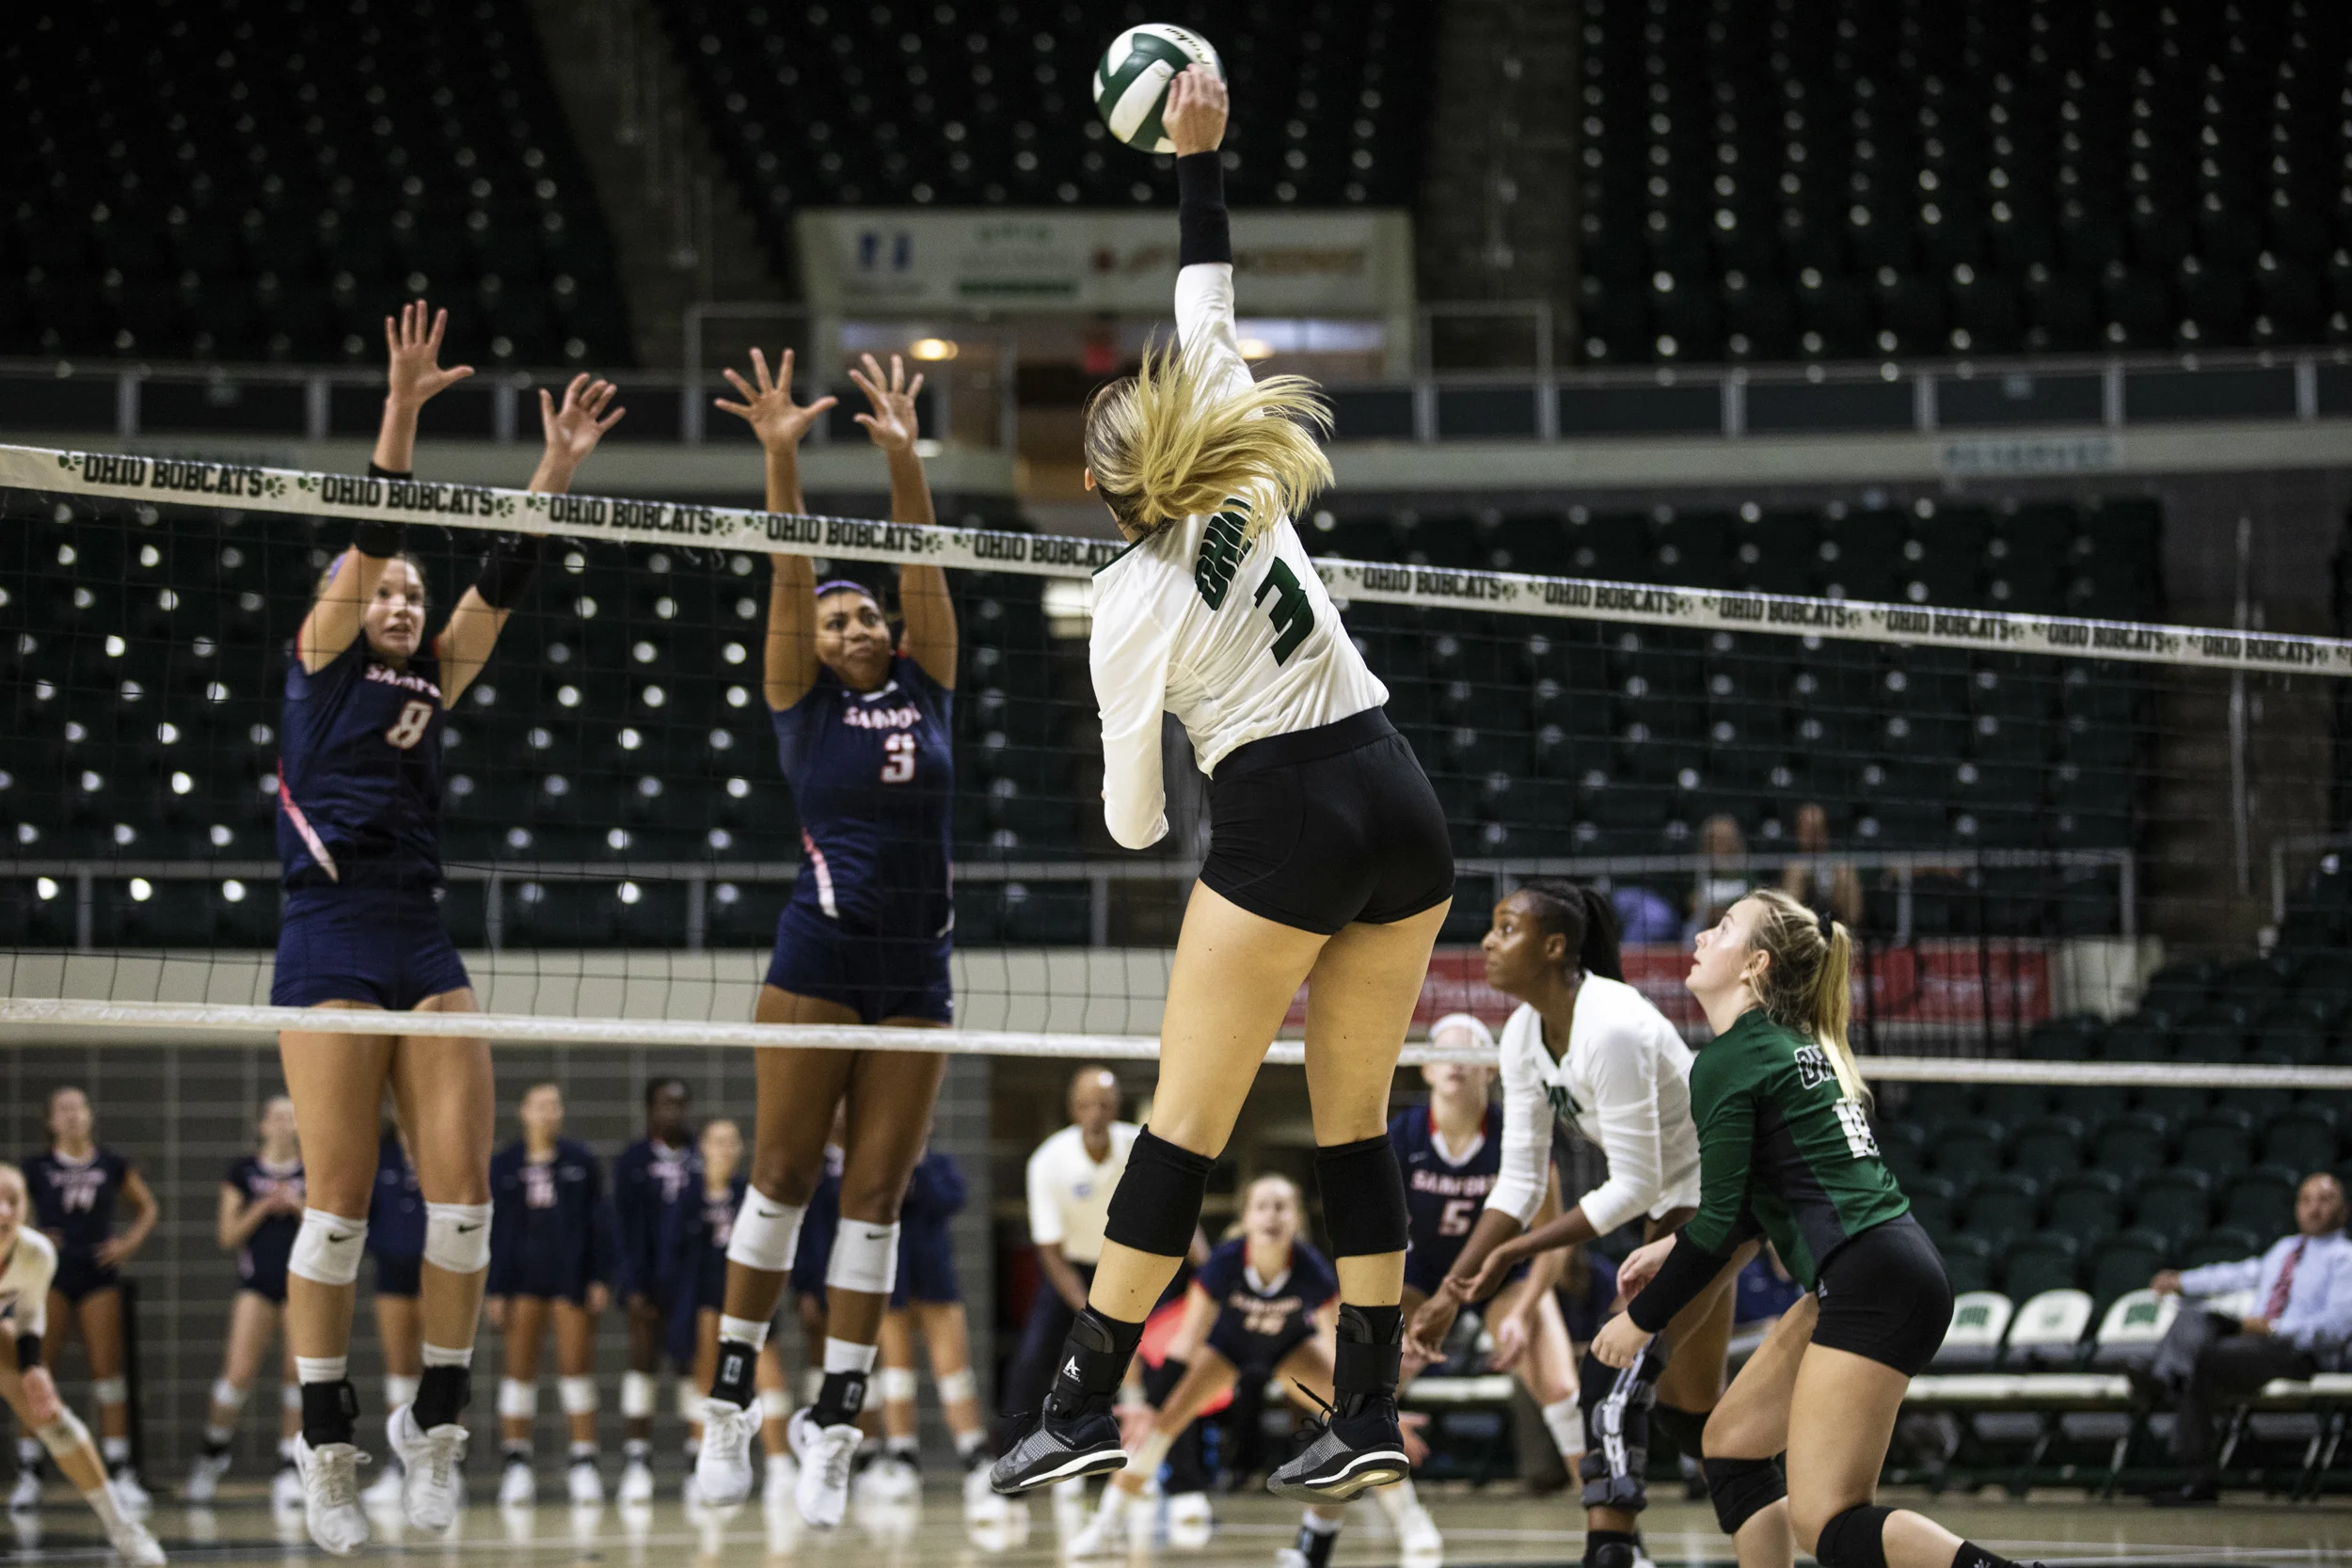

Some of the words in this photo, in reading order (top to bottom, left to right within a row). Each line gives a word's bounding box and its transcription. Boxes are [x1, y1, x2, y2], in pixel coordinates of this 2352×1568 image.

[83, 454, 144, 486] OHIO
[151, 460, 263, 498] BOBCATS
[322, 475, 381, 507] OHIO
[387, 482, 494, 516] BOBCATS
[550, 496, 607, 526] OHIO
[612, 499, 713, 535] BOBCATS
[767, 515, 820, 544] OHIO
[826, 518, 924, 553] BOBCATS
[975, 532, 1026, 562] OHIO
[1031, 536, 1124, 567] BOBCAT
[1364, 567, 1410, 593] OHIO
[1415, 571, 1501, 600] BOBCATS
[1546, 581, 1591, 608] OHIO
[1596, 586, 1677, 614] BOBCATS
[1254, 555, 1315, 667] 3
[1720, 596, 1763, 621] OHIO
[1768, 600, 1846, 628] BOBCATS
[385, 699, 434, 750] 8
[881, 733, 915, 783] 3
[1438, 1197, 1476, 1238] 5
